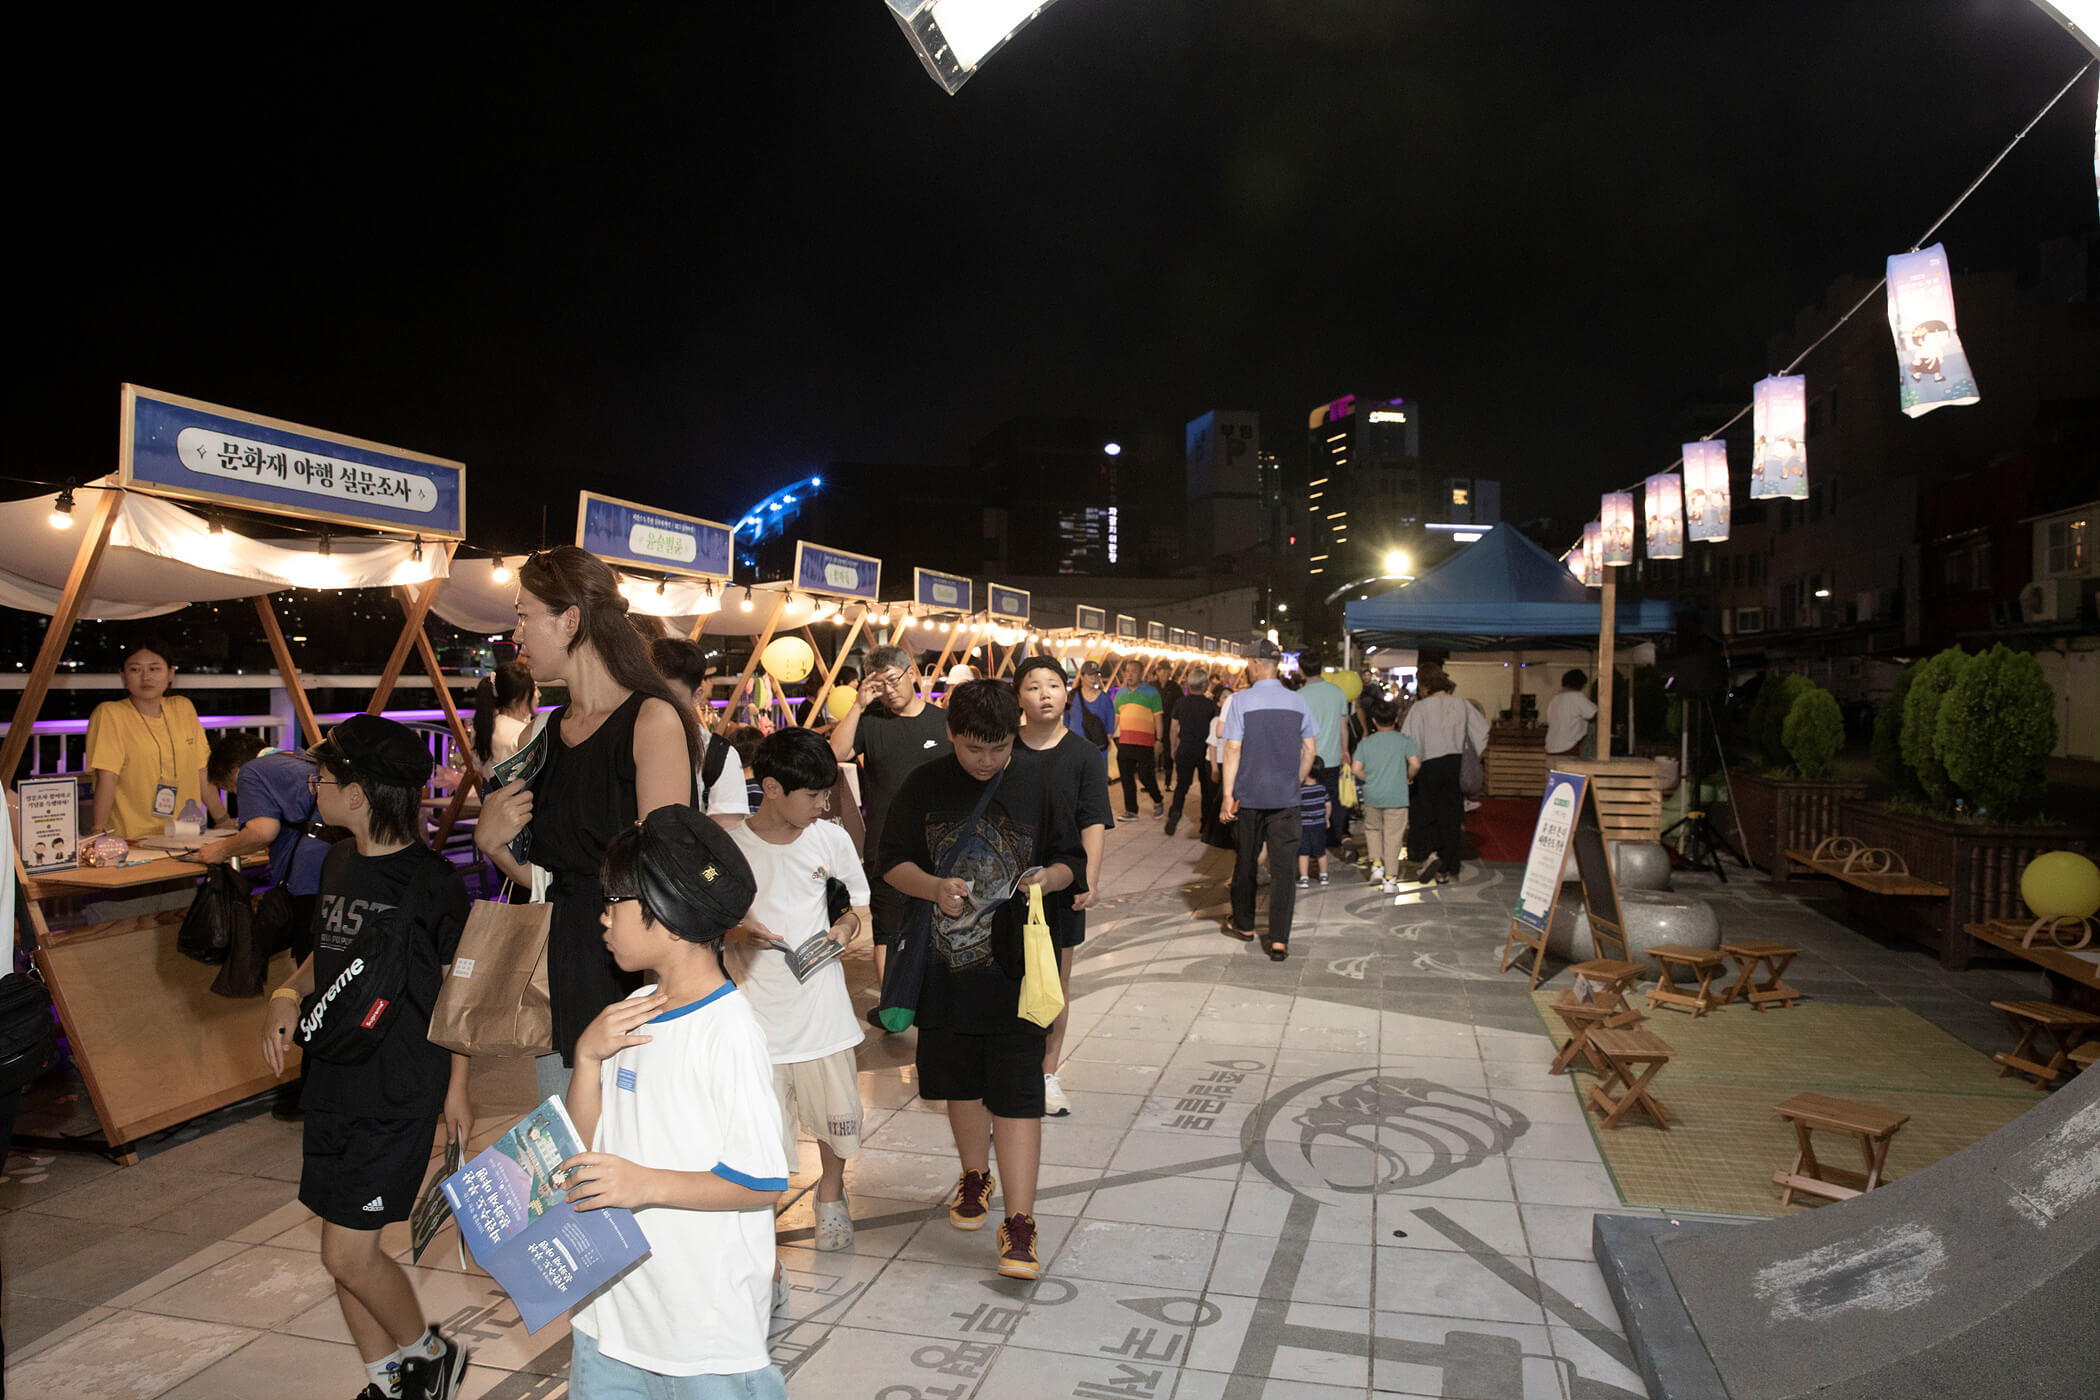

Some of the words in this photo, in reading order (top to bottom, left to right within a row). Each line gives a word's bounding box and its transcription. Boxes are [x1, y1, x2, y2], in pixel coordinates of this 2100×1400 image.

[217, 442, 287, 480] 문화재
[294, 457, 334, 488] 야행
[339, 467, 411, 502] 설문조사
[300, 957, 365, 1042] Supreme
[366, 1000, 385, 1027] Supreme
[461, 1170, 479, 1196] 부산
[474, 1167, 492, 1193] 야행
[473, 1194, 501, 1243] 피란수도
[485, 1190, 511, 1228] 문화재
[527, 1242, 543, 1260] 부산
[538, 1239, 553, 1257] 야행
[542, 1258, 567, 1292] 피란수도
[552, 1255, 572, 1282] 문화재
